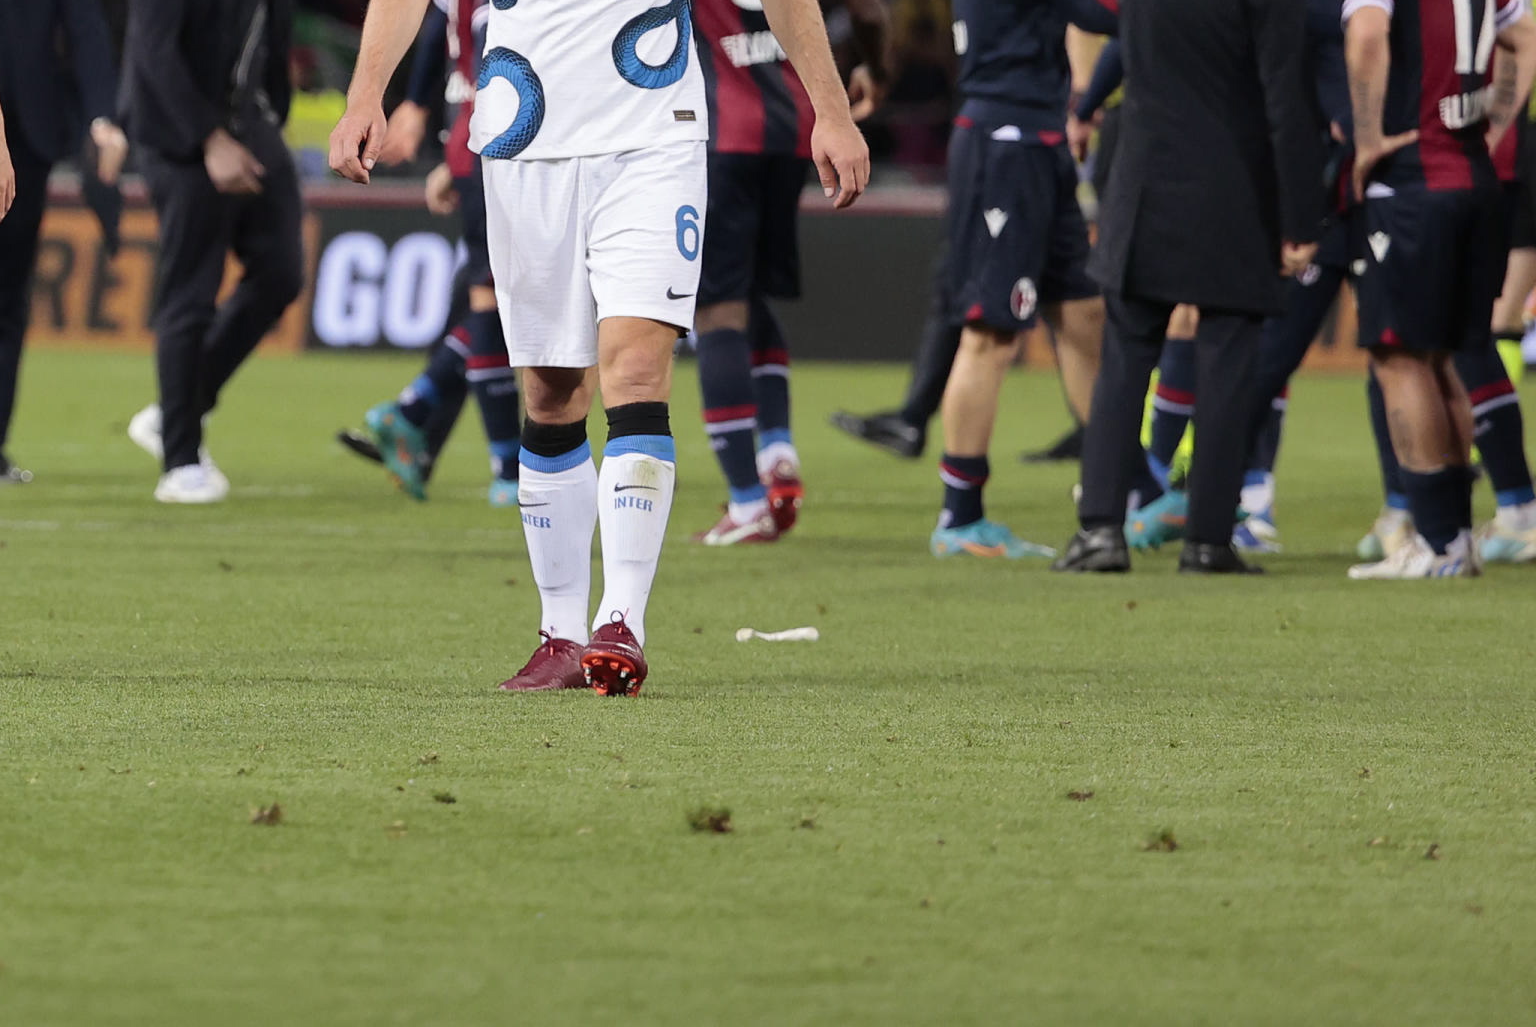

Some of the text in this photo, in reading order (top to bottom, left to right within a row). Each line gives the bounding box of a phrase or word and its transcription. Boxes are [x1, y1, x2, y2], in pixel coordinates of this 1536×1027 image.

[675, 204, 700, 262] 6
[312, 230, 468, 348] GO
[614, 495, 653, 513] INTER
